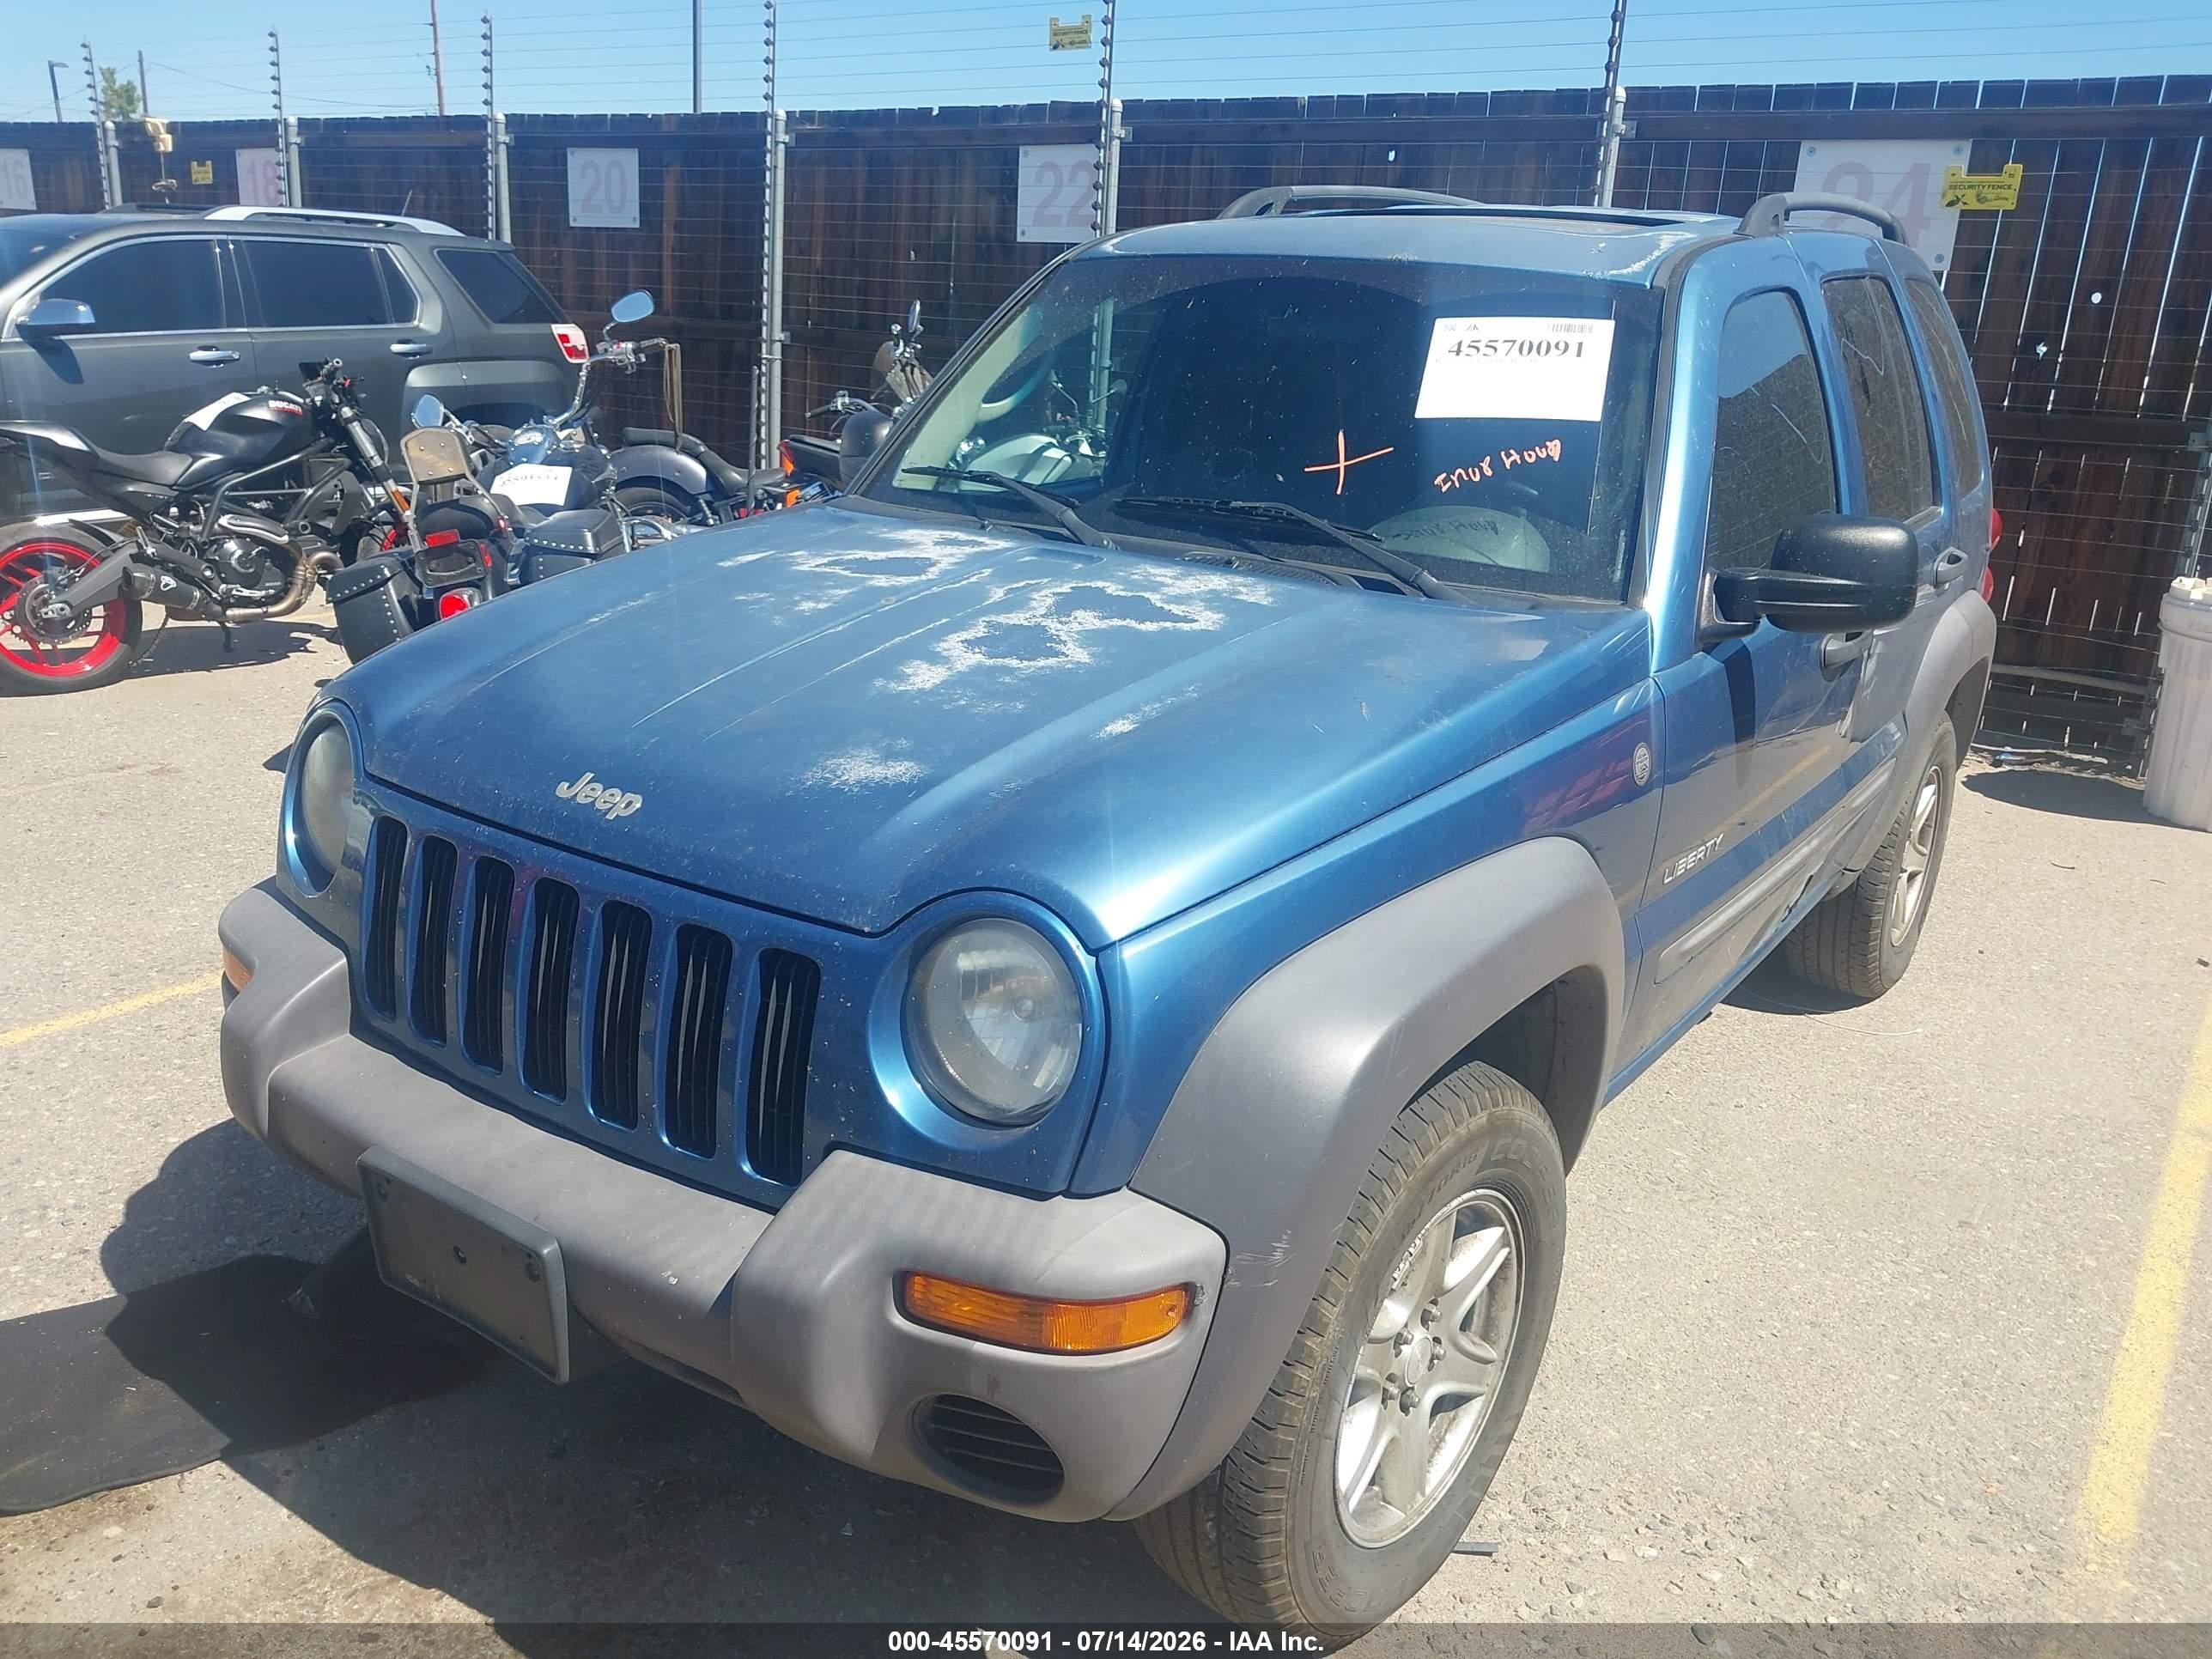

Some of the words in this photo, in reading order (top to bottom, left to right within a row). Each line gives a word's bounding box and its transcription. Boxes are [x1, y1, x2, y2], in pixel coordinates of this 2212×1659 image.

[580, 159, 628, 215] 20
[1033, 161, 1097, 227] 22
[1820, 161, 1932, 248] 24
[1447, 338, 1584, 358] 45570091
[556, 771, 644, 821] Jeep
[1662, 833, 1724, 885] LIBERTY
